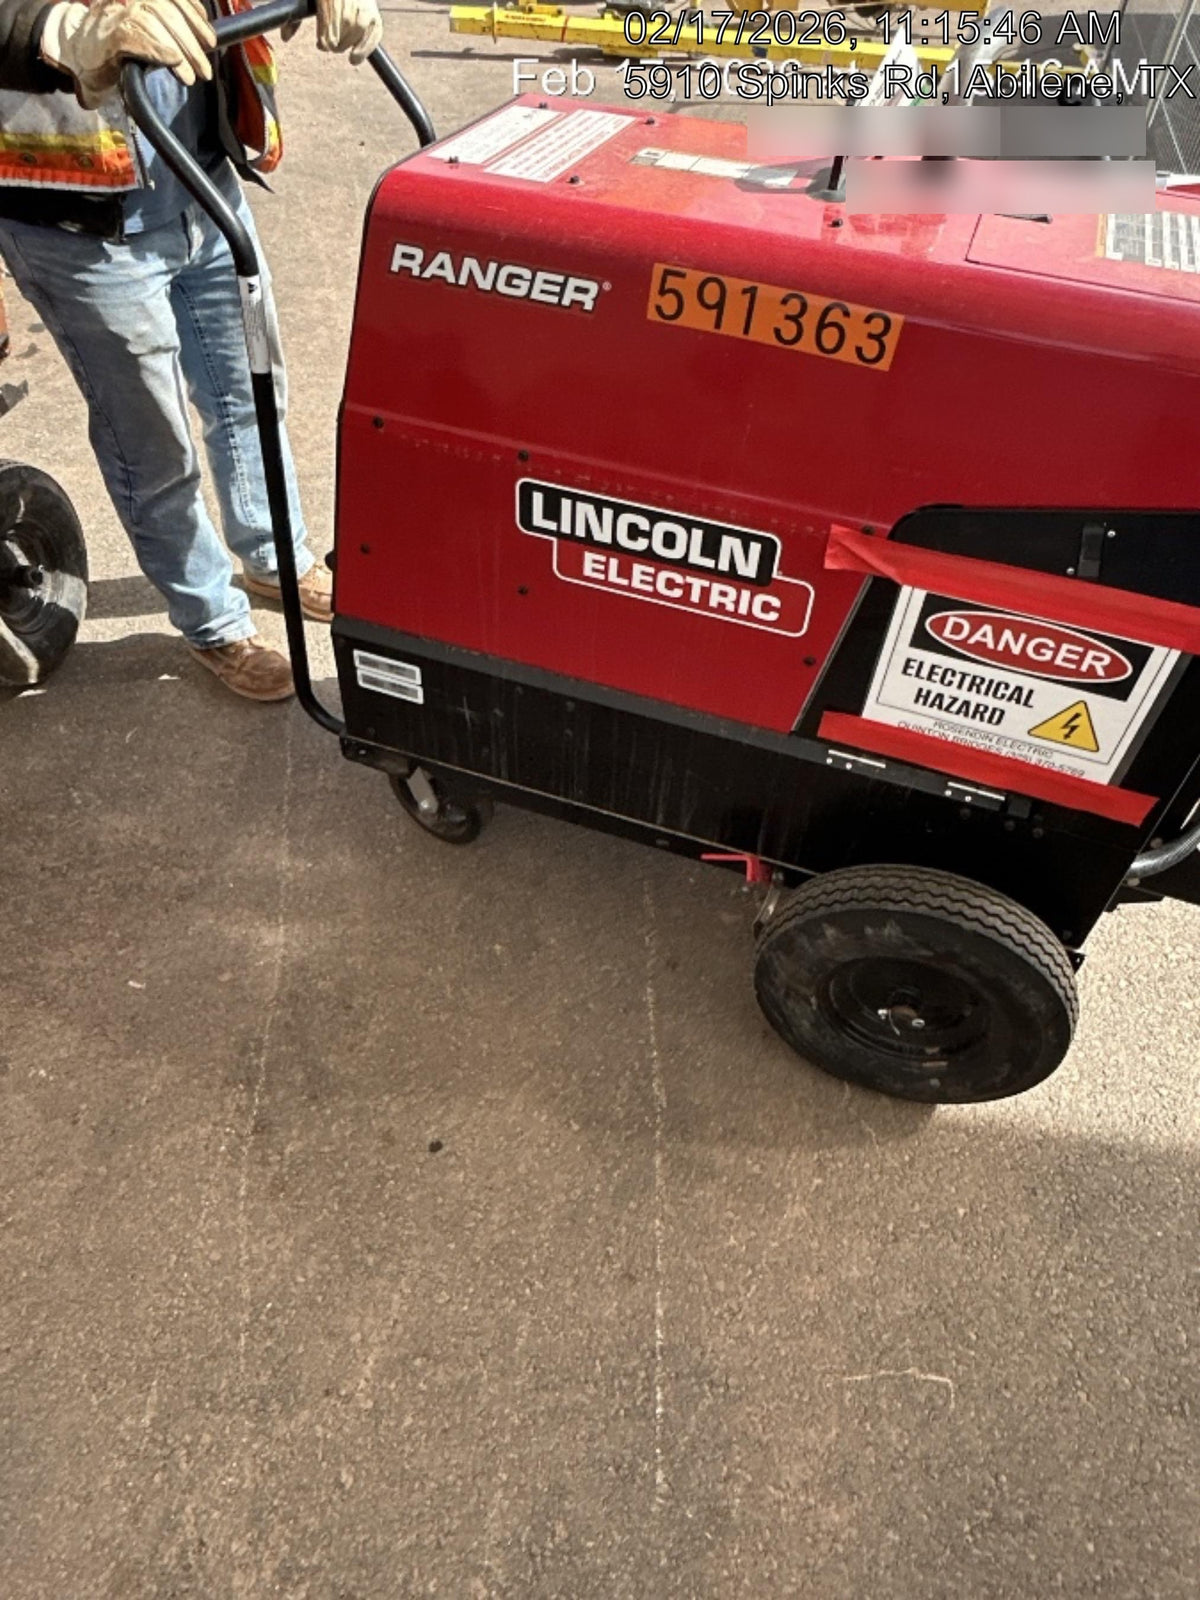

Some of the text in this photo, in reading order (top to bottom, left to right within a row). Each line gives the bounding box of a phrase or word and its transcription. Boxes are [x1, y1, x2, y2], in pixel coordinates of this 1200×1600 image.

[389, 242, 599, 311] RANGER
[654, 268, 893, 367] 591363
[531, 490, 762, 579] LINCOLN
[582, 551, 782, 622] ELECTRIC
[941, 614, 1113, 678] DANGER
[901, 656, 1035, 709] ELECTRICAL
[913, 687, 1006, 727] HAZARD
